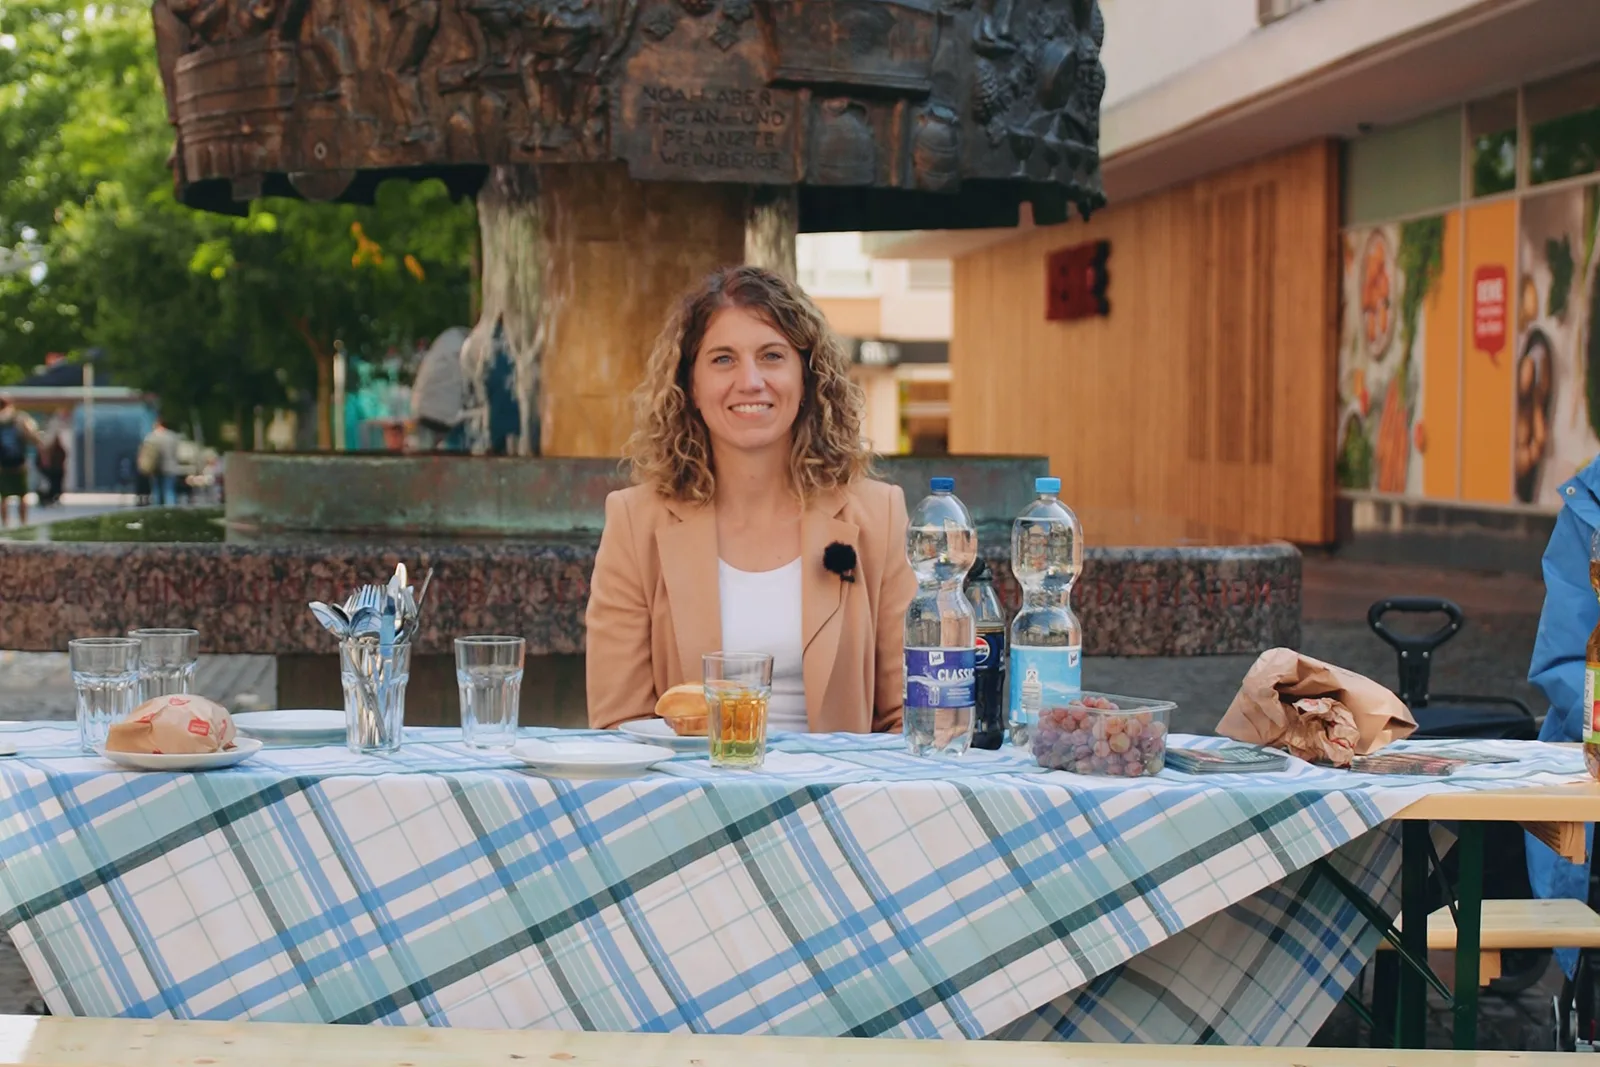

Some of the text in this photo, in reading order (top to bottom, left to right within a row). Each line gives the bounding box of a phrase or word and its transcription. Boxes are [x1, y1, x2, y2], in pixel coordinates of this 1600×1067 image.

[716, 89, 772, 106] ABER
[741, 110, 786, 126] UND
[662, 129, 777, 148] PFLANZTE
[660, 151, 781, 170] WEINBERGE
[937, 667, 975, 681] CLASSIC
